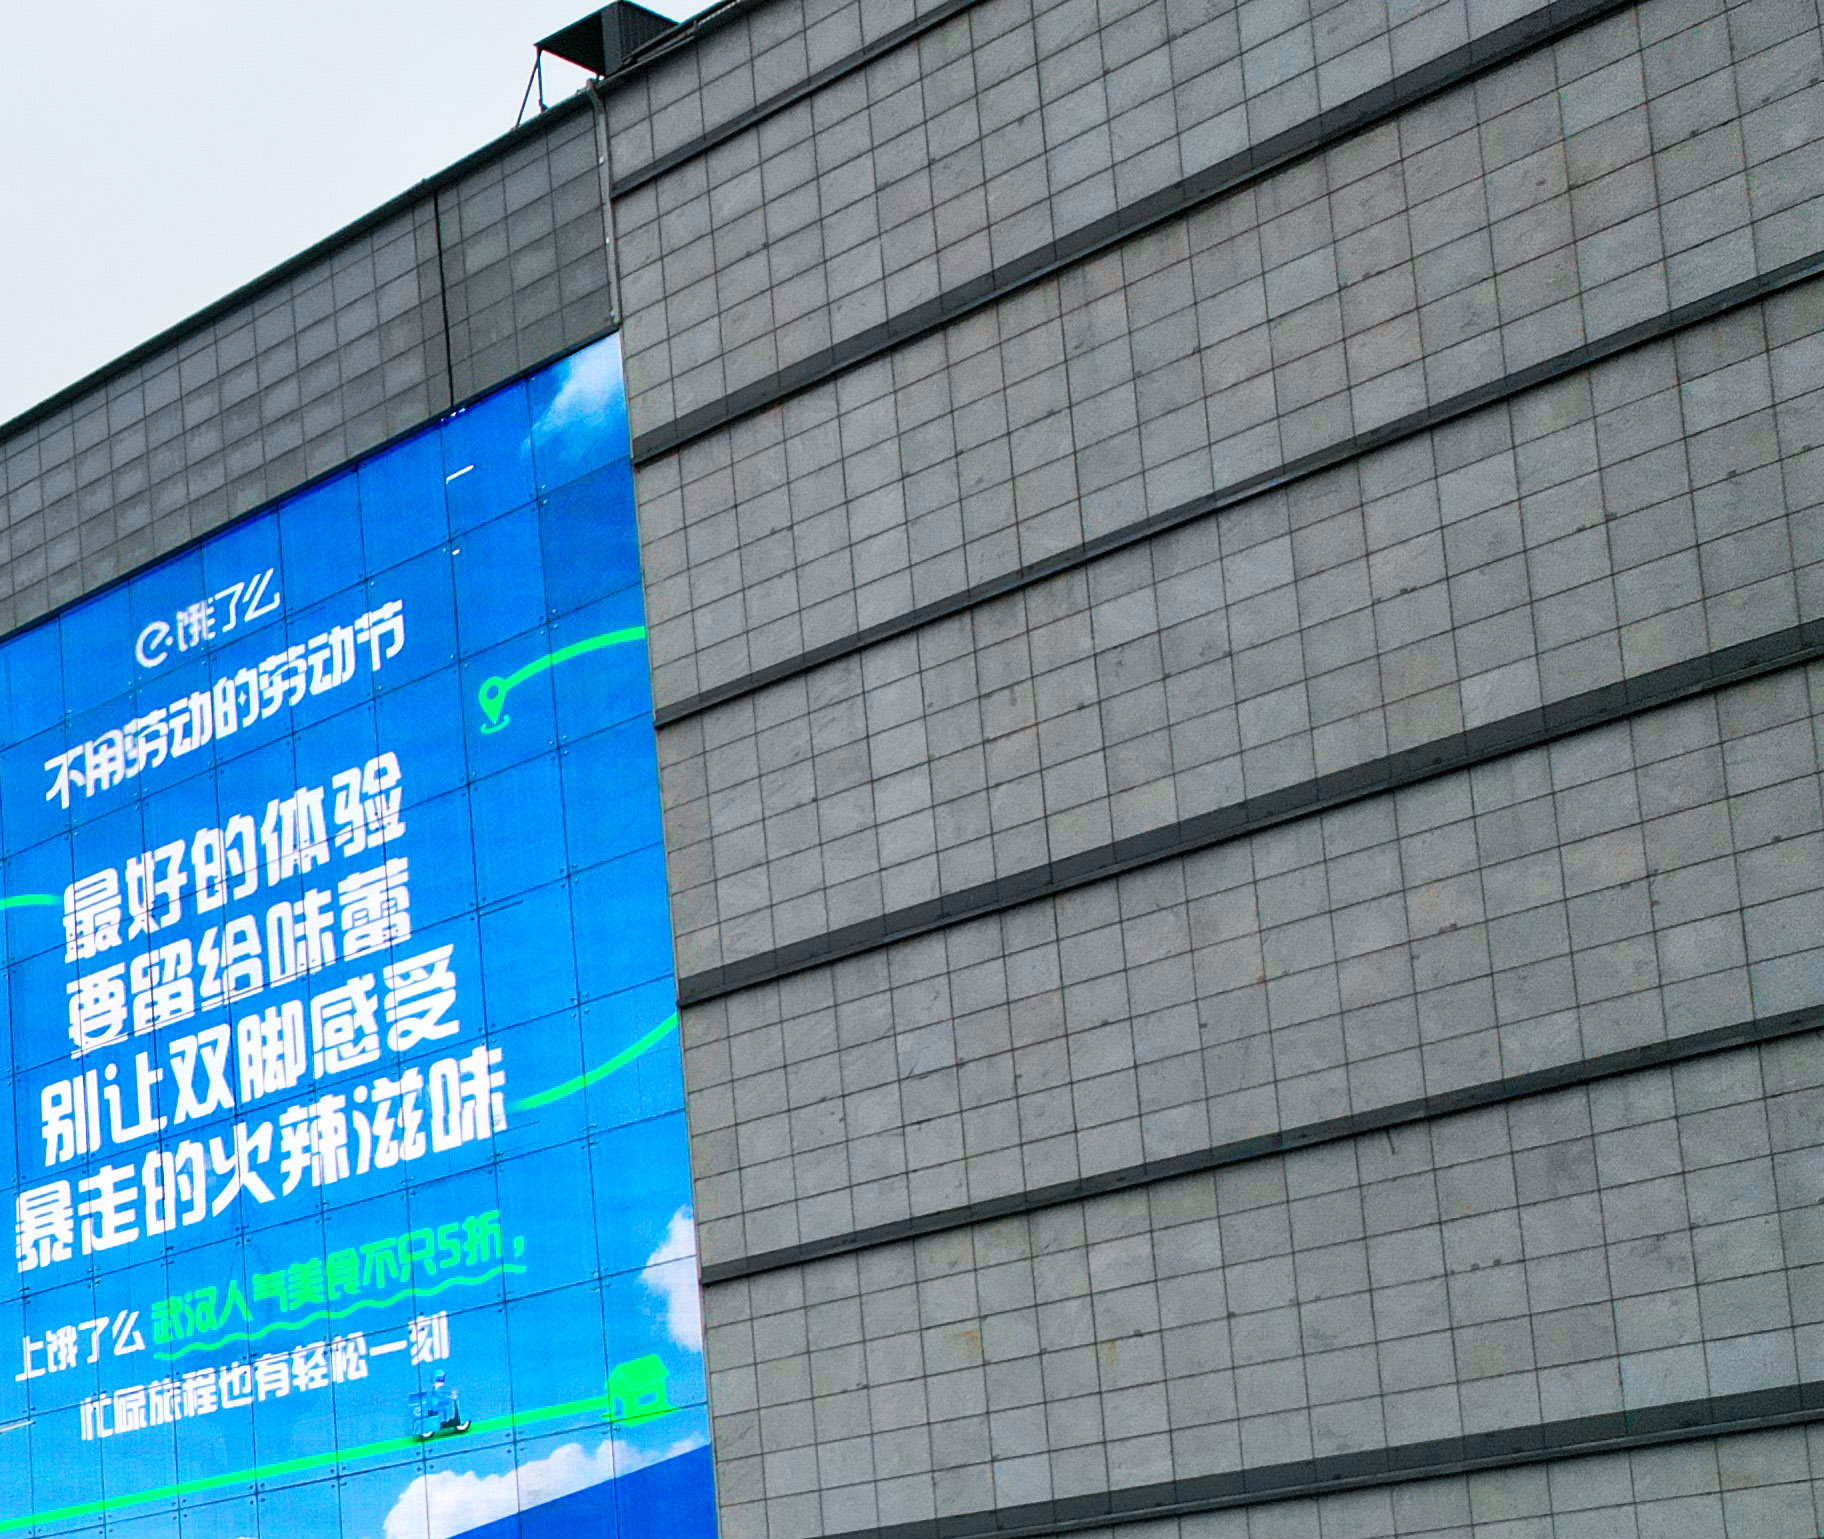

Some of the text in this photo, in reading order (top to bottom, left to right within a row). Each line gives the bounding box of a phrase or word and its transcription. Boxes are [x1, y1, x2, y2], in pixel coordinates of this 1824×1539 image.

[44, 600, 405, 809] 不用劳动的劳动节
[62, 750, 408, 963] 最好的体验
[66, 858, 412, 1059] 要留给味蕾
[15, 1047, 507, 1273] 暴走的火辣滋味
[41, 944, 460, 1167] 别让双脚感受
[79, 1311, 451, 1441] 忙碌旅程也有轻松一刻
